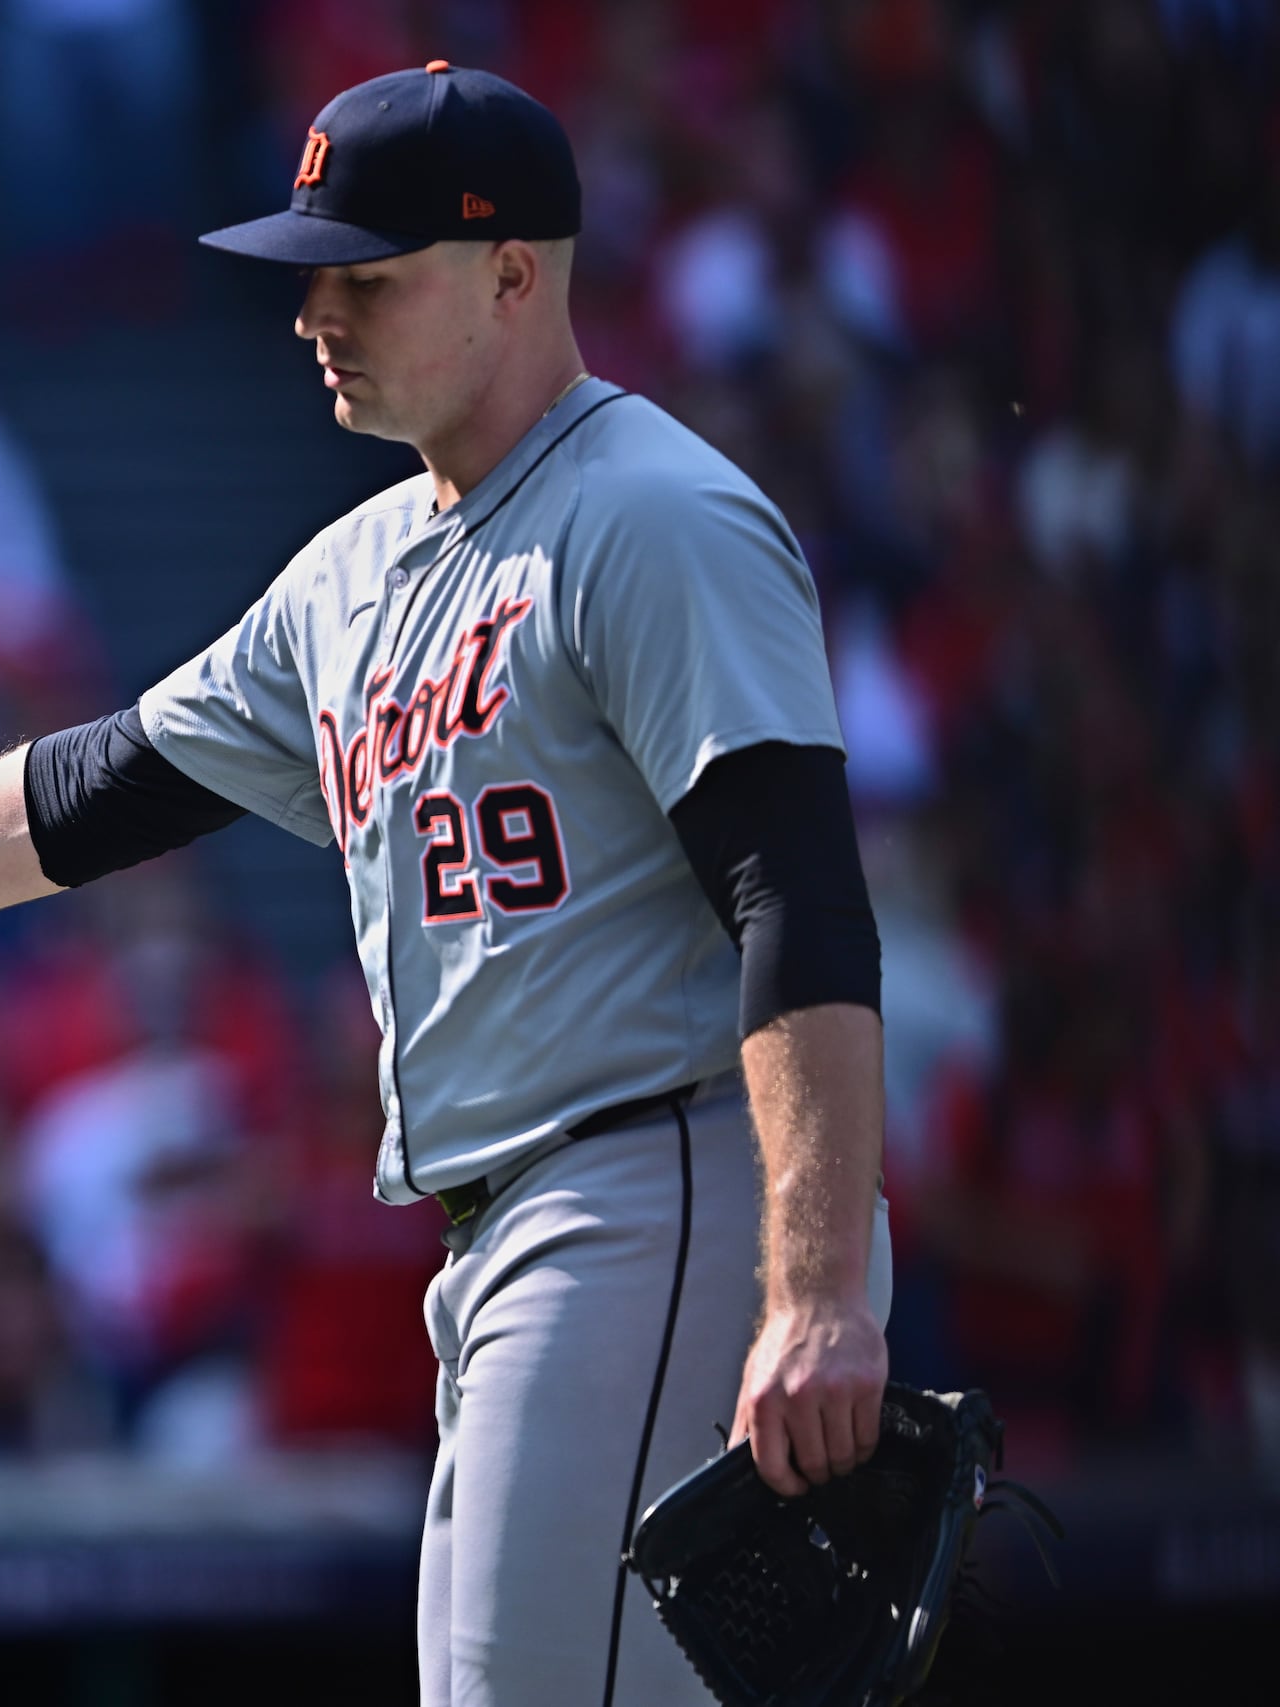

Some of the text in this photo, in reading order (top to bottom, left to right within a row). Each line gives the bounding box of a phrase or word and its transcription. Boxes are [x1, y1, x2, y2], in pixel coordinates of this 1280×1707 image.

[293, 125, 331, 190] D
[319, 597, 532, 866] Detroit
[414, 780, 570, 926] 29
